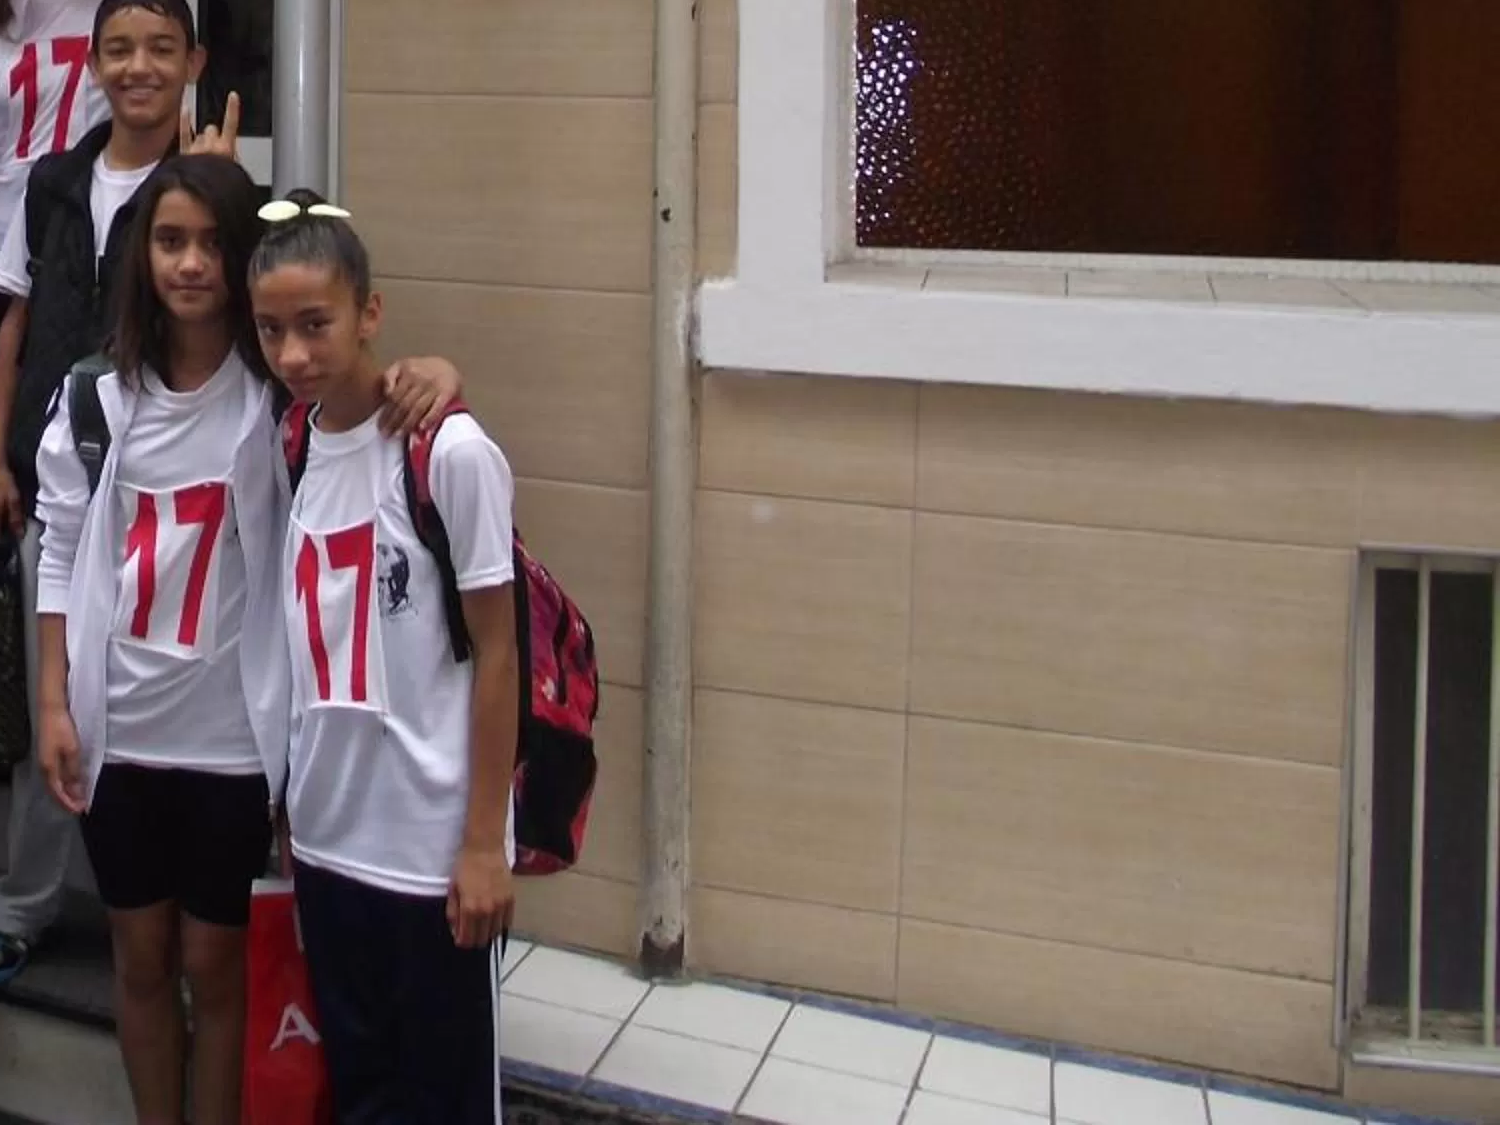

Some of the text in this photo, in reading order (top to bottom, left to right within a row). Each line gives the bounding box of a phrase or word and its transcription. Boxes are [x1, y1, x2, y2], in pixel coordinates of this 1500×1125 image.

[9, 34, 90, 160] 17
[124, 481, 228, 647] 17
[295, 521, 375, 702] 17
